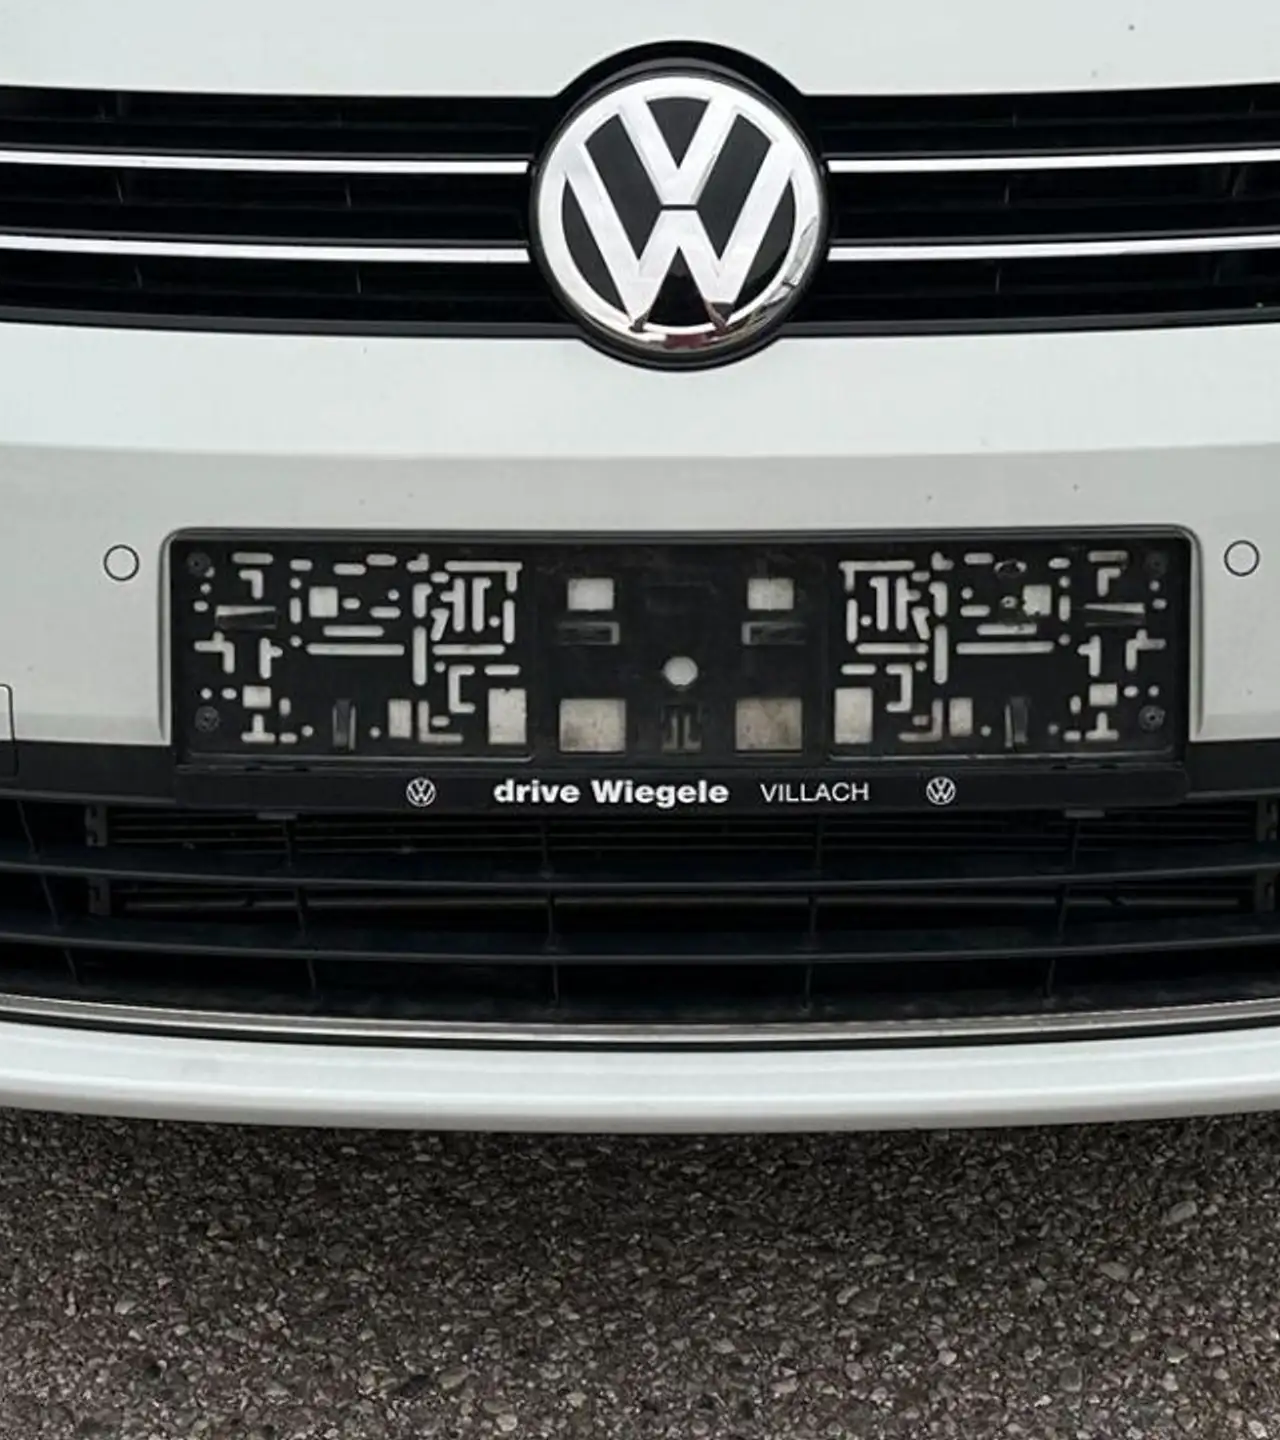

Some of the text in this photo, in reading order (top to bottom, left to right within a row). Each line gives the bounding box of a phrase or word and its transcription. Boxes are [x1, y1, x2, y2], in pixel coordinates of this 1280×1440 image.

[493, 778, 581, 803] drive
[591, 778, 729, 809] Wiegele
[759, 782, 869, 803] VILLACH
